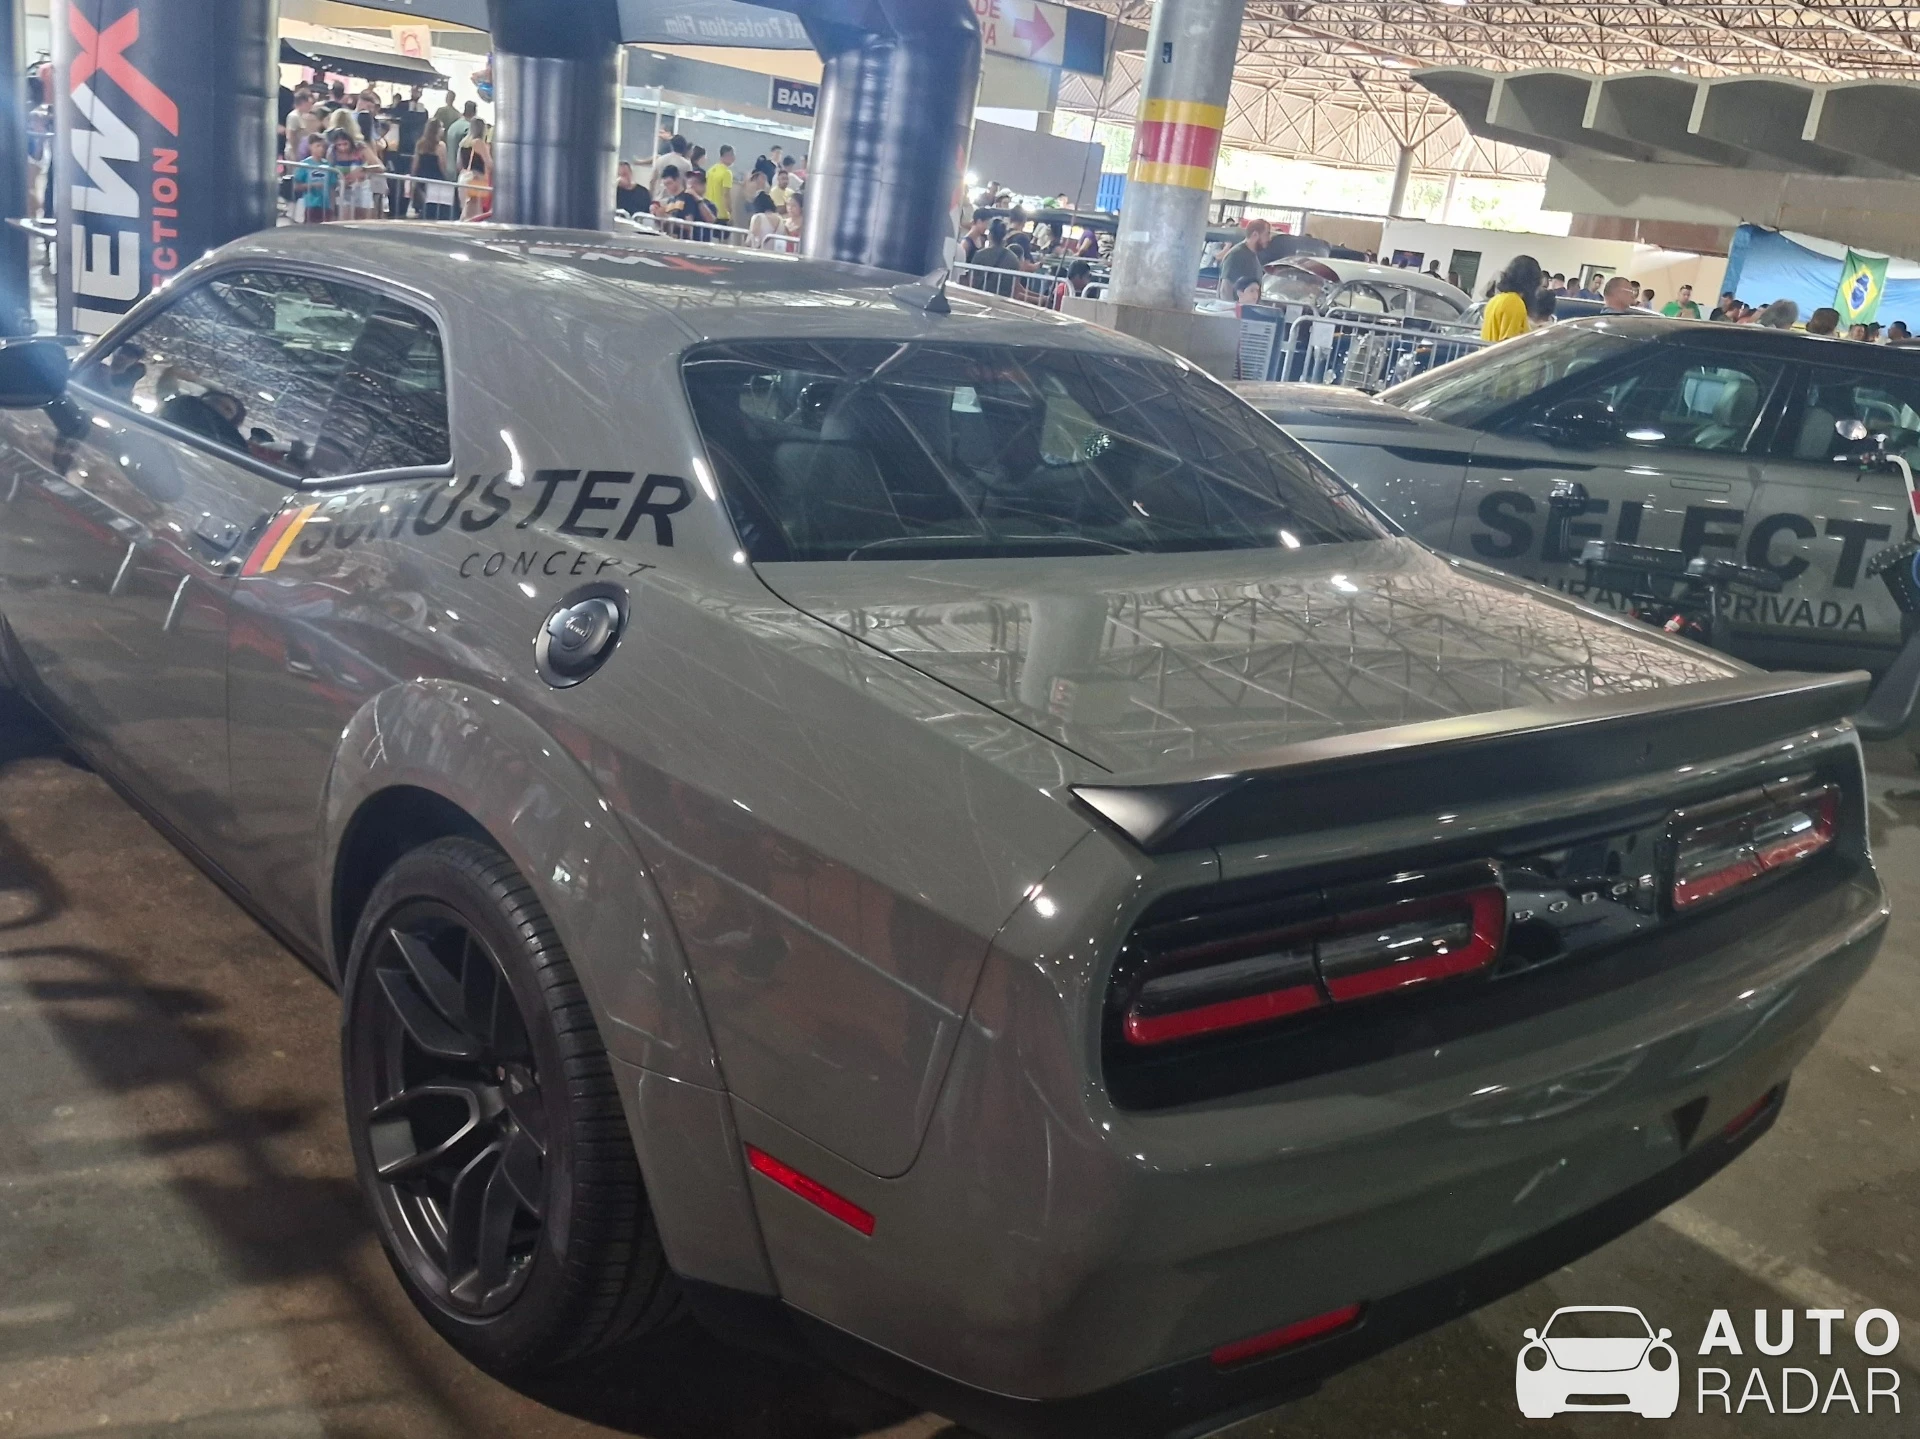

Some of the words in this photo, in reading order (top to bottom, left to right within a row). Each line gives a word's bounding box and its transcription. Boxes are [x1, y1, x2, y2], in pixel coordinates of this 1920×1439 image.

[777, 87, 814, 109] BAR
[458, 548, 656, 580] CONCEPT
[1513, 873, 1655, 923] DODGE
